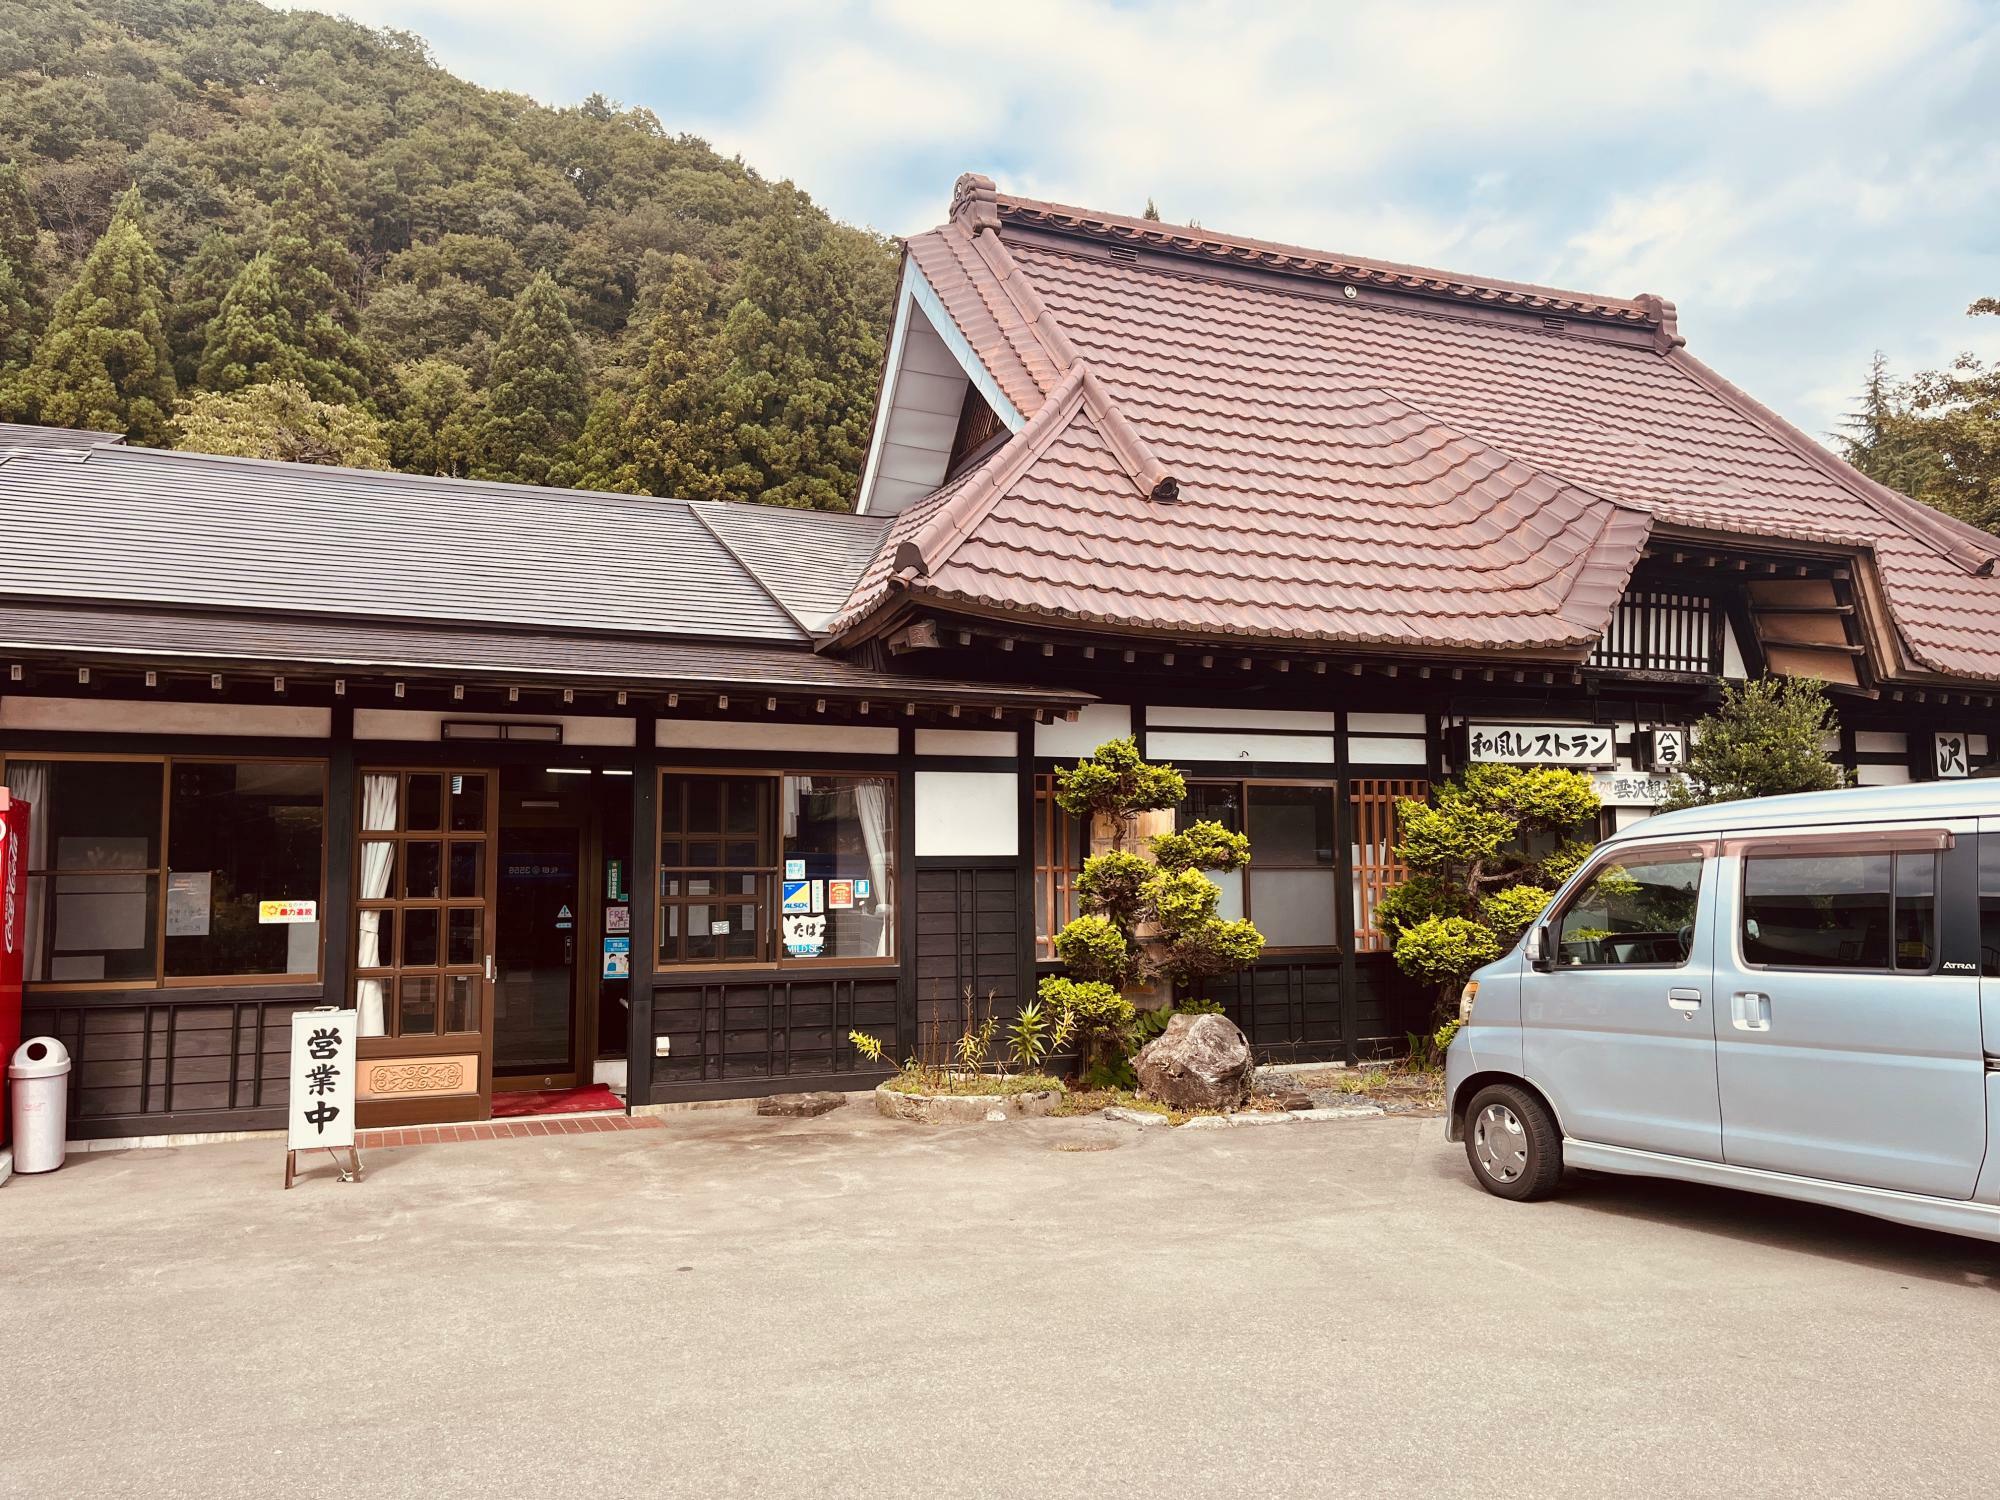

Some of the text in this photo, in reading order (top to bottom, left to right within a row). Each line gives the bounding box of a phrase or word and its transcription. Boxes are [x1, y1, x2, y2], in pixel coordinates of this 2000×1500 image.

[1471, 731, 1608, 758] 和風レストラン
[1939, 737, 1965, 774] 沢
[609, 919, 629, 928] Wi-F
[1942, 961, 1976, 969] ATRAI
[304, 1028, 343, 1135] 営業中
